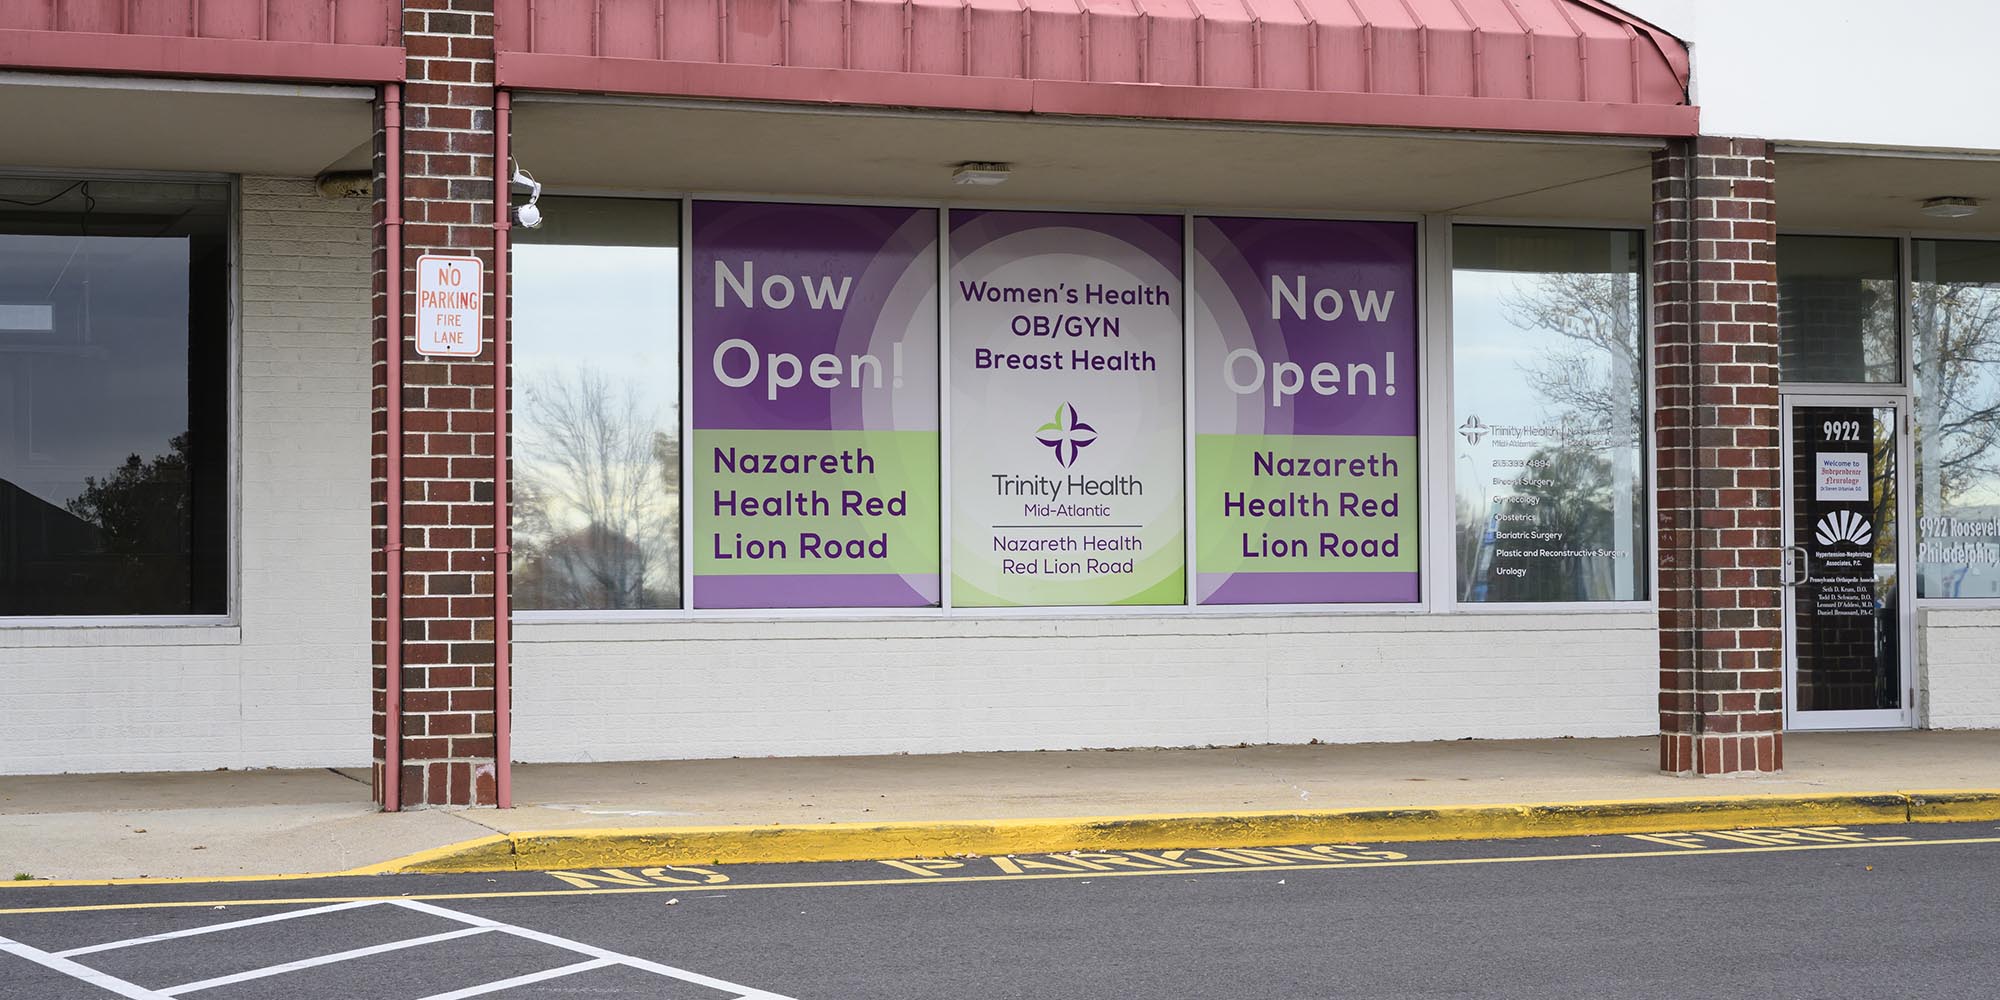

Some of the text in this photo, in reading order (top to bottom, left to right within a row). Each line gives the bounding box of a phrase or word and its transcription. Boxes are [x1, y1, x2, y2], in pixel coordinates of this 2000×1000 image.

[439, 268, 461, 286] NO
[714, 260, 853, 310] Now
[422, 291, 477, 310] PARKING
[960, 280, 1170, 306] Women's Health
[1271, 275, 1395, 322] Now
[437, 314, 462, 326] FIRE
[1011, 314, 1120, 339] OB/GYN
[434, 331, 464, 344] LANE
[713, 338, 904, 400] Open!
[975, 348, 1156, 371] Breast Health
[1223, 348, 1396, 407] Open!
[1489, 425, 1559, 439] Trinity Health
[1823, 421, 1860, 440] 9922
[713, 447, 875, 474] Nazareth
[1254, 451, 1398, 477] Nazareth
[1821, 467, 1862, 475] Independence
[992, 474, 1143, 502] Trinity Health
[1522, 478, 1555, 488] Surgery
[1825, 477, 1859, 485] Neurology
[713, 490, 907, 517] Health Red
[1024, 503, 1110, 517] Mid-Atlantic
[1224, 492, 1398, 518] Health Red
[1492, 496, 1540, 505] Gynecology
[1493, 513, 1536, 521] Obstetrics
[1496, 531, 1563, 541] Bariatric Surgery
[1920, 517, 1947, 537] 9922
[714, 533, 888, 559] Lion Road
[993, 535, 1142, 551] Nazareth Health
[1242, 533, 1399, 558] Lion Road
[1496, 549, 1629, 559] Plastic and Reconstructive Surgery
[1919, 542, 2000, 568] Philadelphia,
[1003, 558, 1133, 574] Red Lion Road
[1496, 567, 1527, 577] Urology
[545, 826, 1913, 889] NO PARKING FIRE
